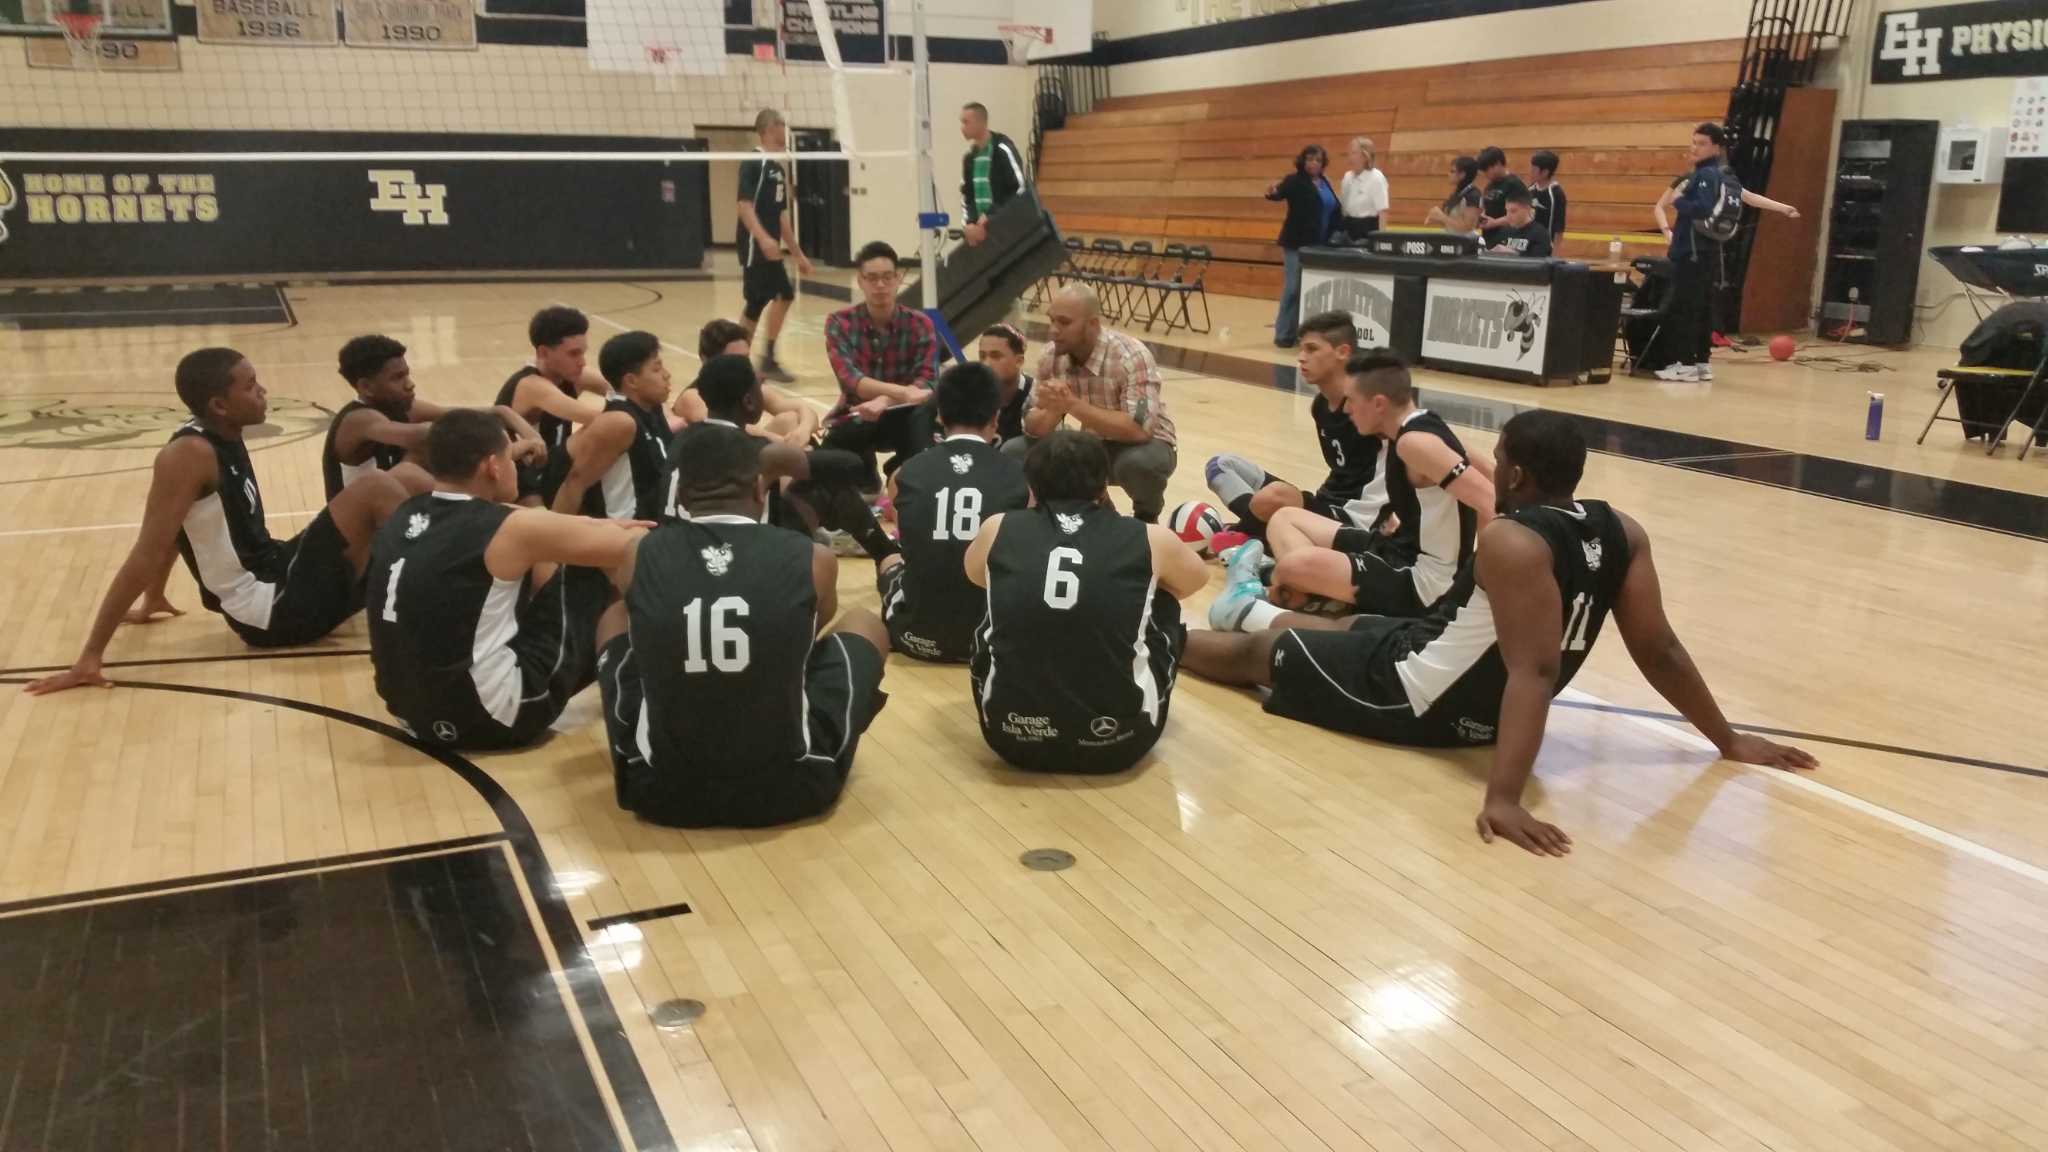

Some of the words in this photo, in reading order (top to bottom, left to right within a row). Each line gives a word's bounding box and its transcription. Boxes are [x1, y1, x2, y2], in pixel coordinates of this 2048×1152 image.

[212, 0, 318, 17] BASEBALL
[236, 21, 302, 40] 1996
[380, 24, 442, 42] 1990
[1879, 12, 1943, 76] EH
[1951, 18, 2048, 57] PHYSI
[23, 173, 106, 194] HOME
[112, 173, 150, 194] OF
[158, 173, 216, 194] THE
[368, 169, 449, 225] EH
[25, 194, 219, 224] HORNETS
[1406, 241, 1426, 255] POSS
[1330, 439, 1346, 467] 3
[932, 486, 983, 541] 18
[382, 557, 406, 623] 1
[1043, 546, 1084, 611] 6
[682, 596, 751, 674] 16
[1560, 592, 1594, 651] 11
[1007, 712, 1050, 727] Garage
[1023, 724, 1059, 737] Verde
